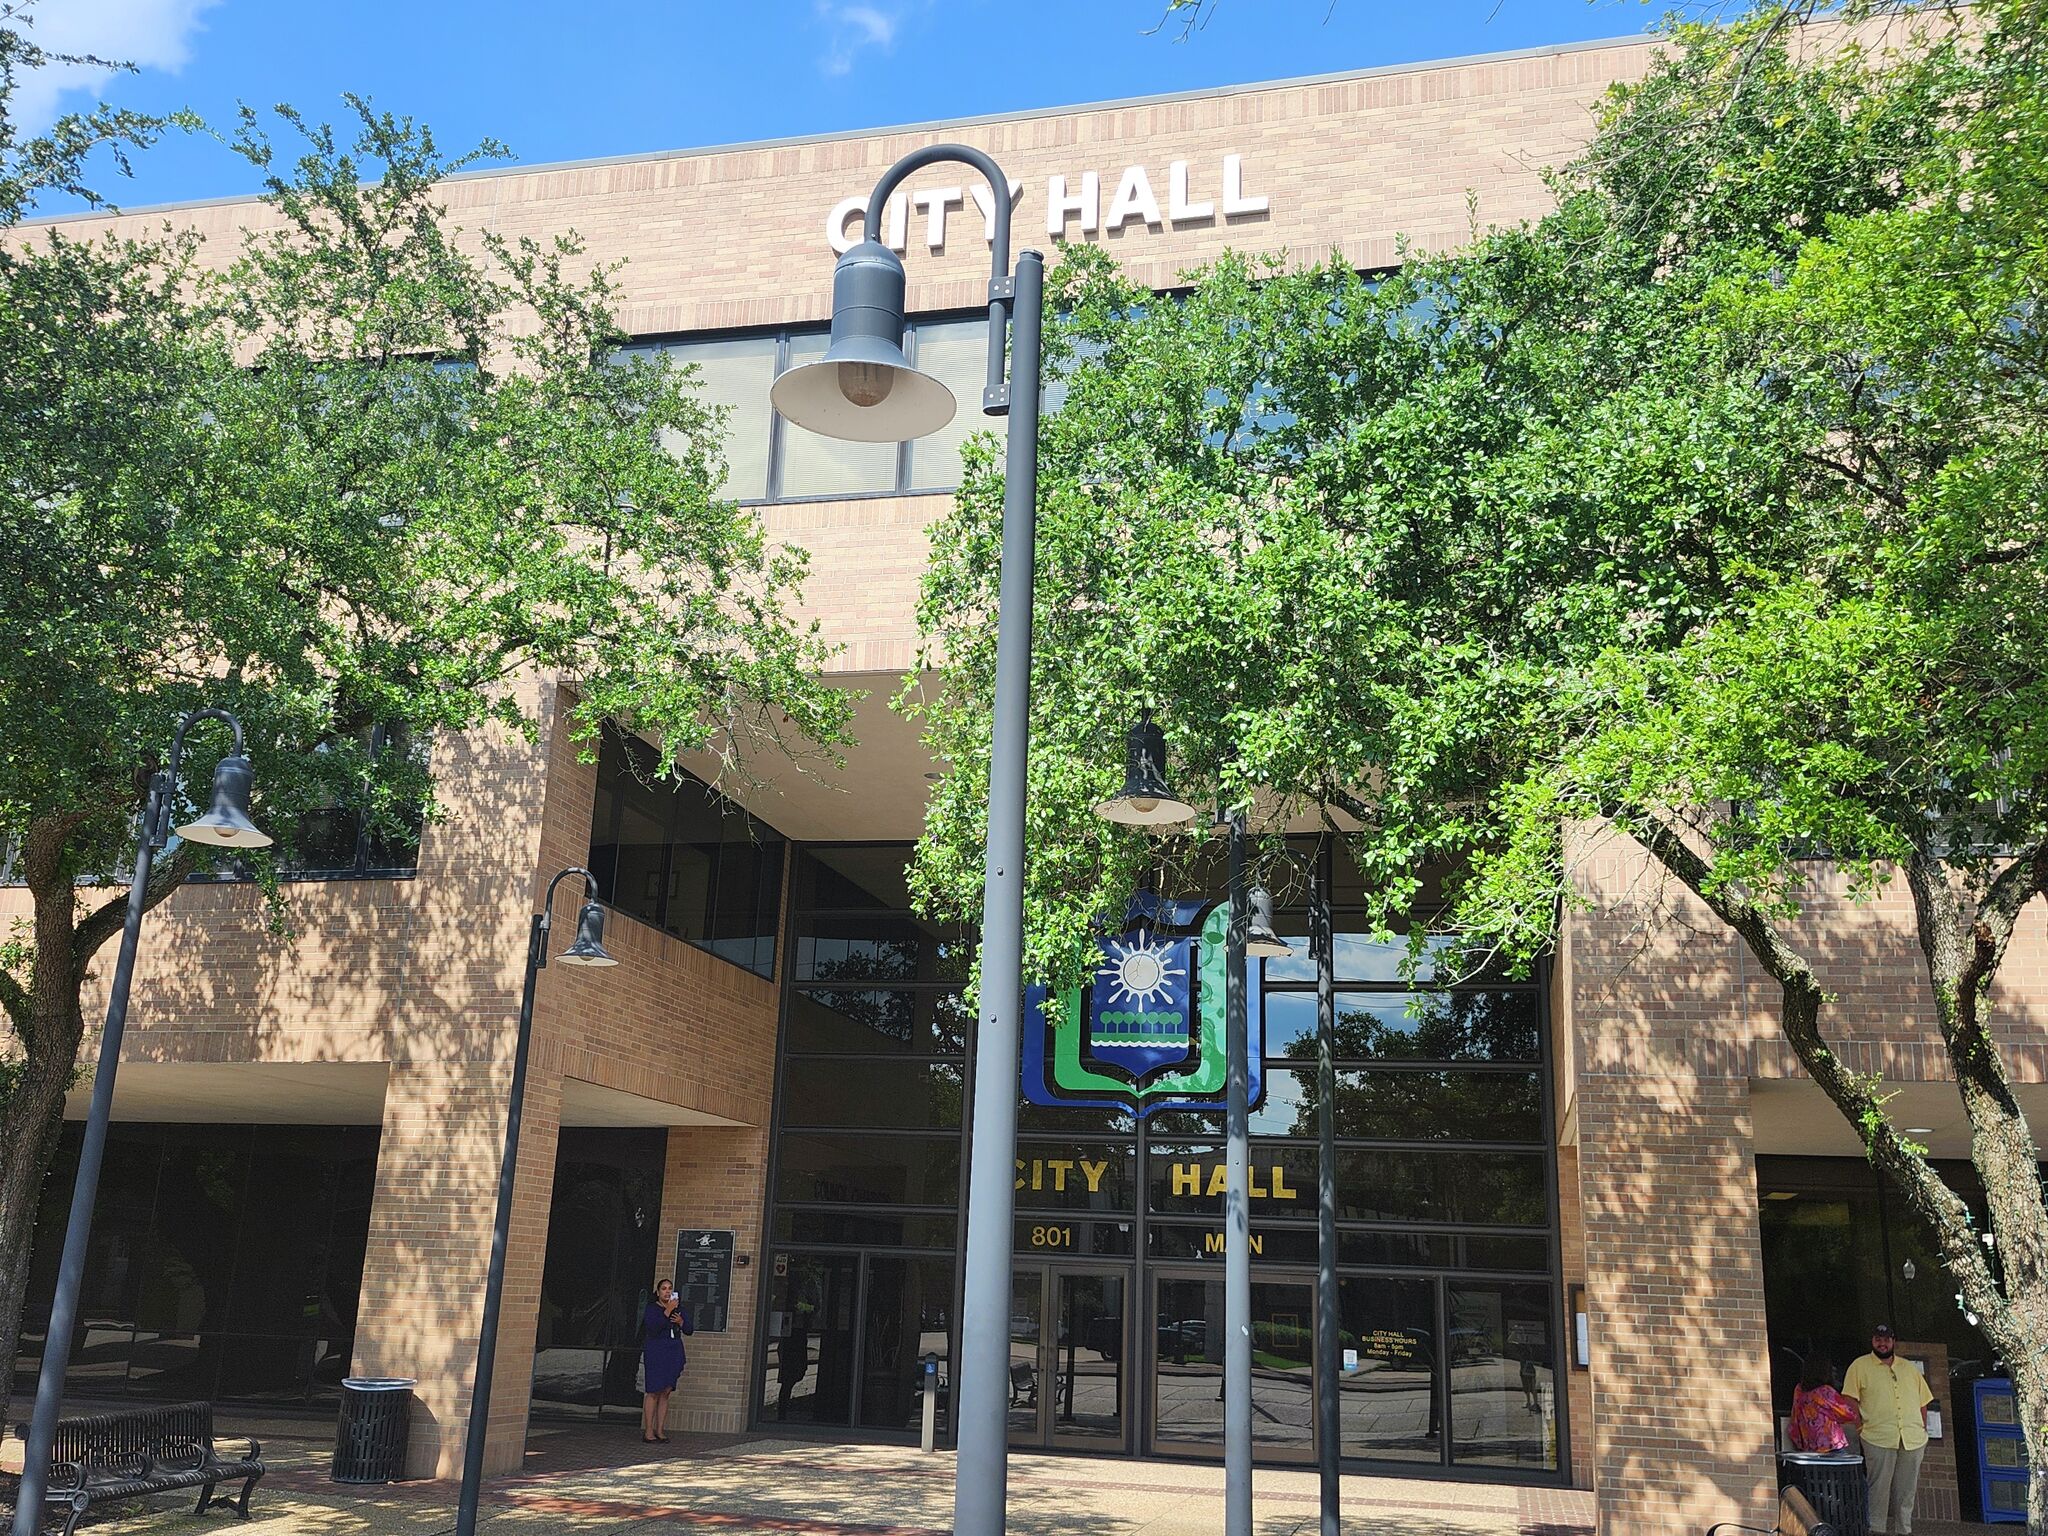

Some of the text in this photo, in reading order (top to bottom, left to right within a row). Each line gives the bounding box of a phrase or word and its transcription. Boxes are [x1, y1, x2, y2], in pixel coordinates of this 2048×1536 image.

[826, 153, 1270, 255] CITY HALL
[1172, 1163, 1297, 1199] HALL
[1031, 1226, 1263, 1255] 801 MN
[1394, 1350, 1412, 1358] Friday
